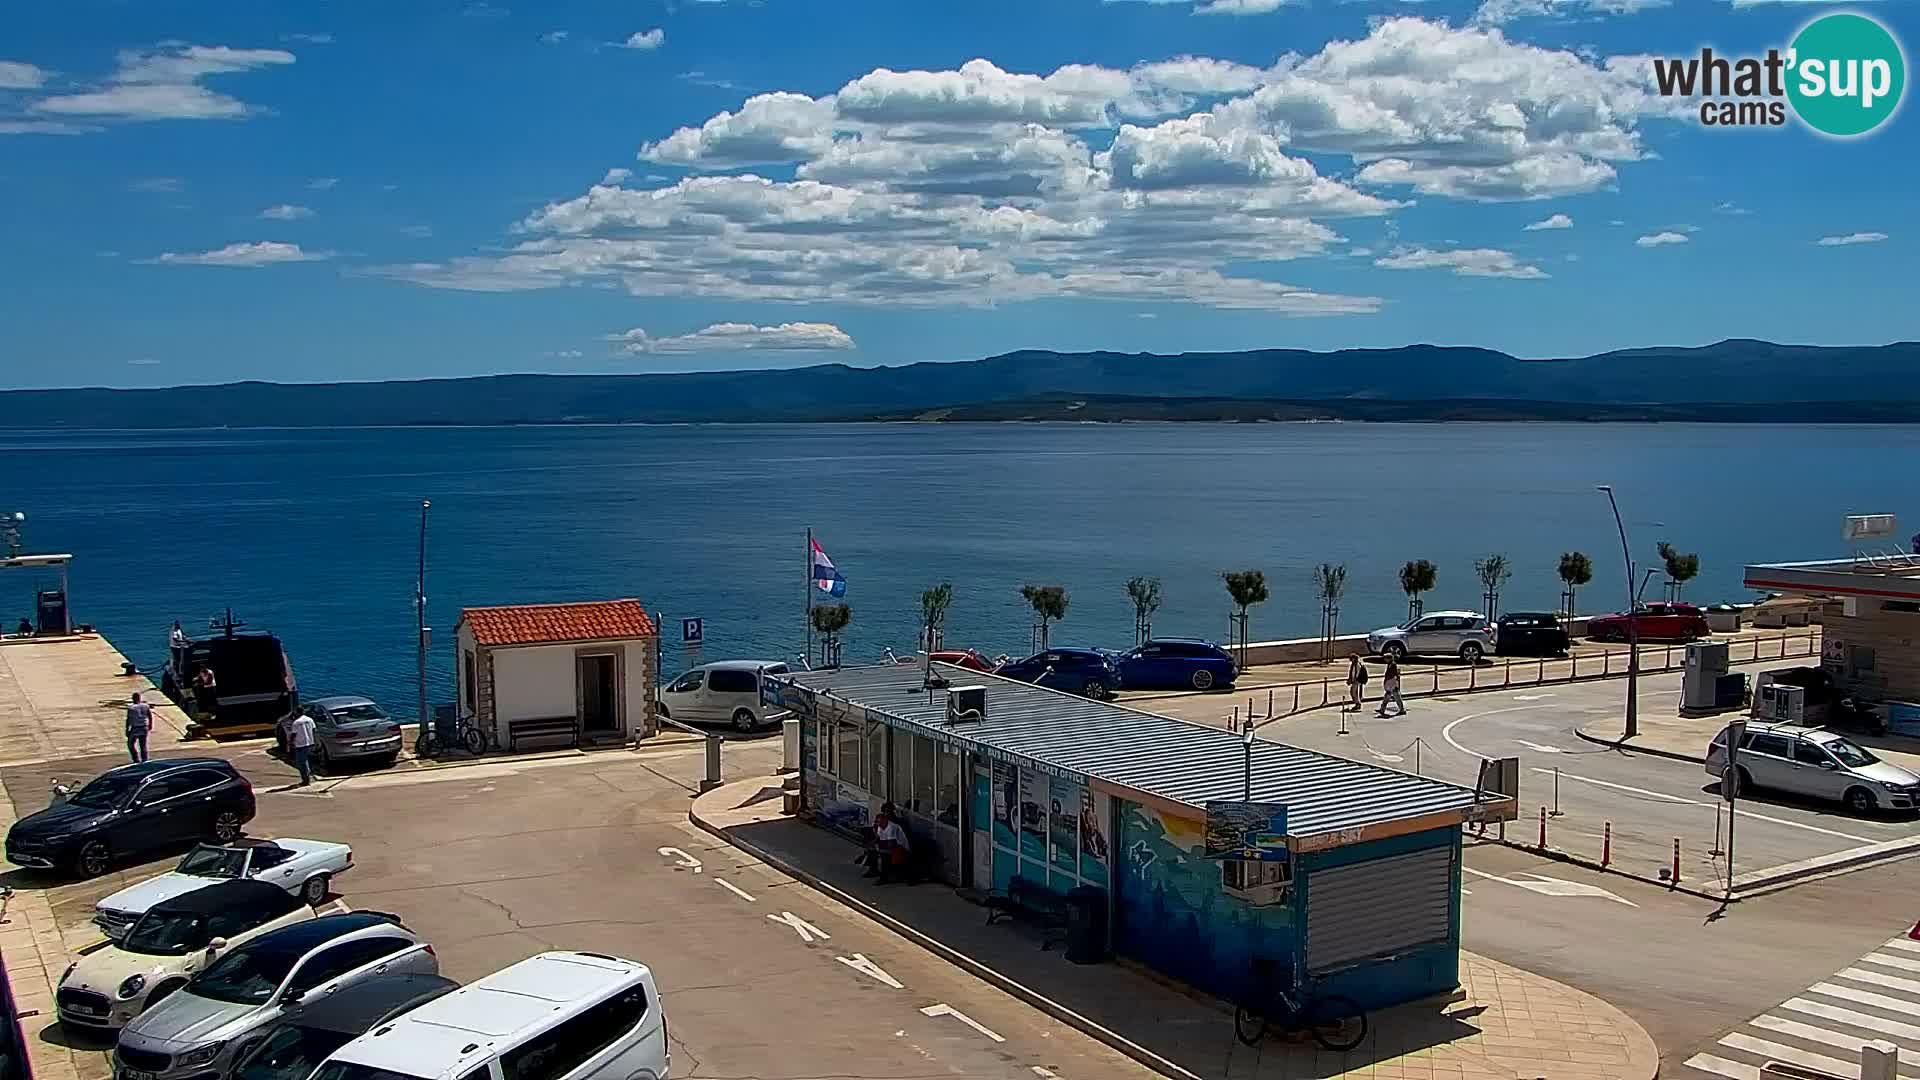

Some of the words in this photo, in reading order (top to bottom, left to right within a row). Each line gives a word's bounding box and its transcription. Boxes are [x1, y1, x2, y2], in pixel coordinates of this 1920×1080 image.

[687, 621, 698, 638] P
[1034, 761, 1059, 777] TICKET
[1060, 770, 1085, 785] OFFICE
